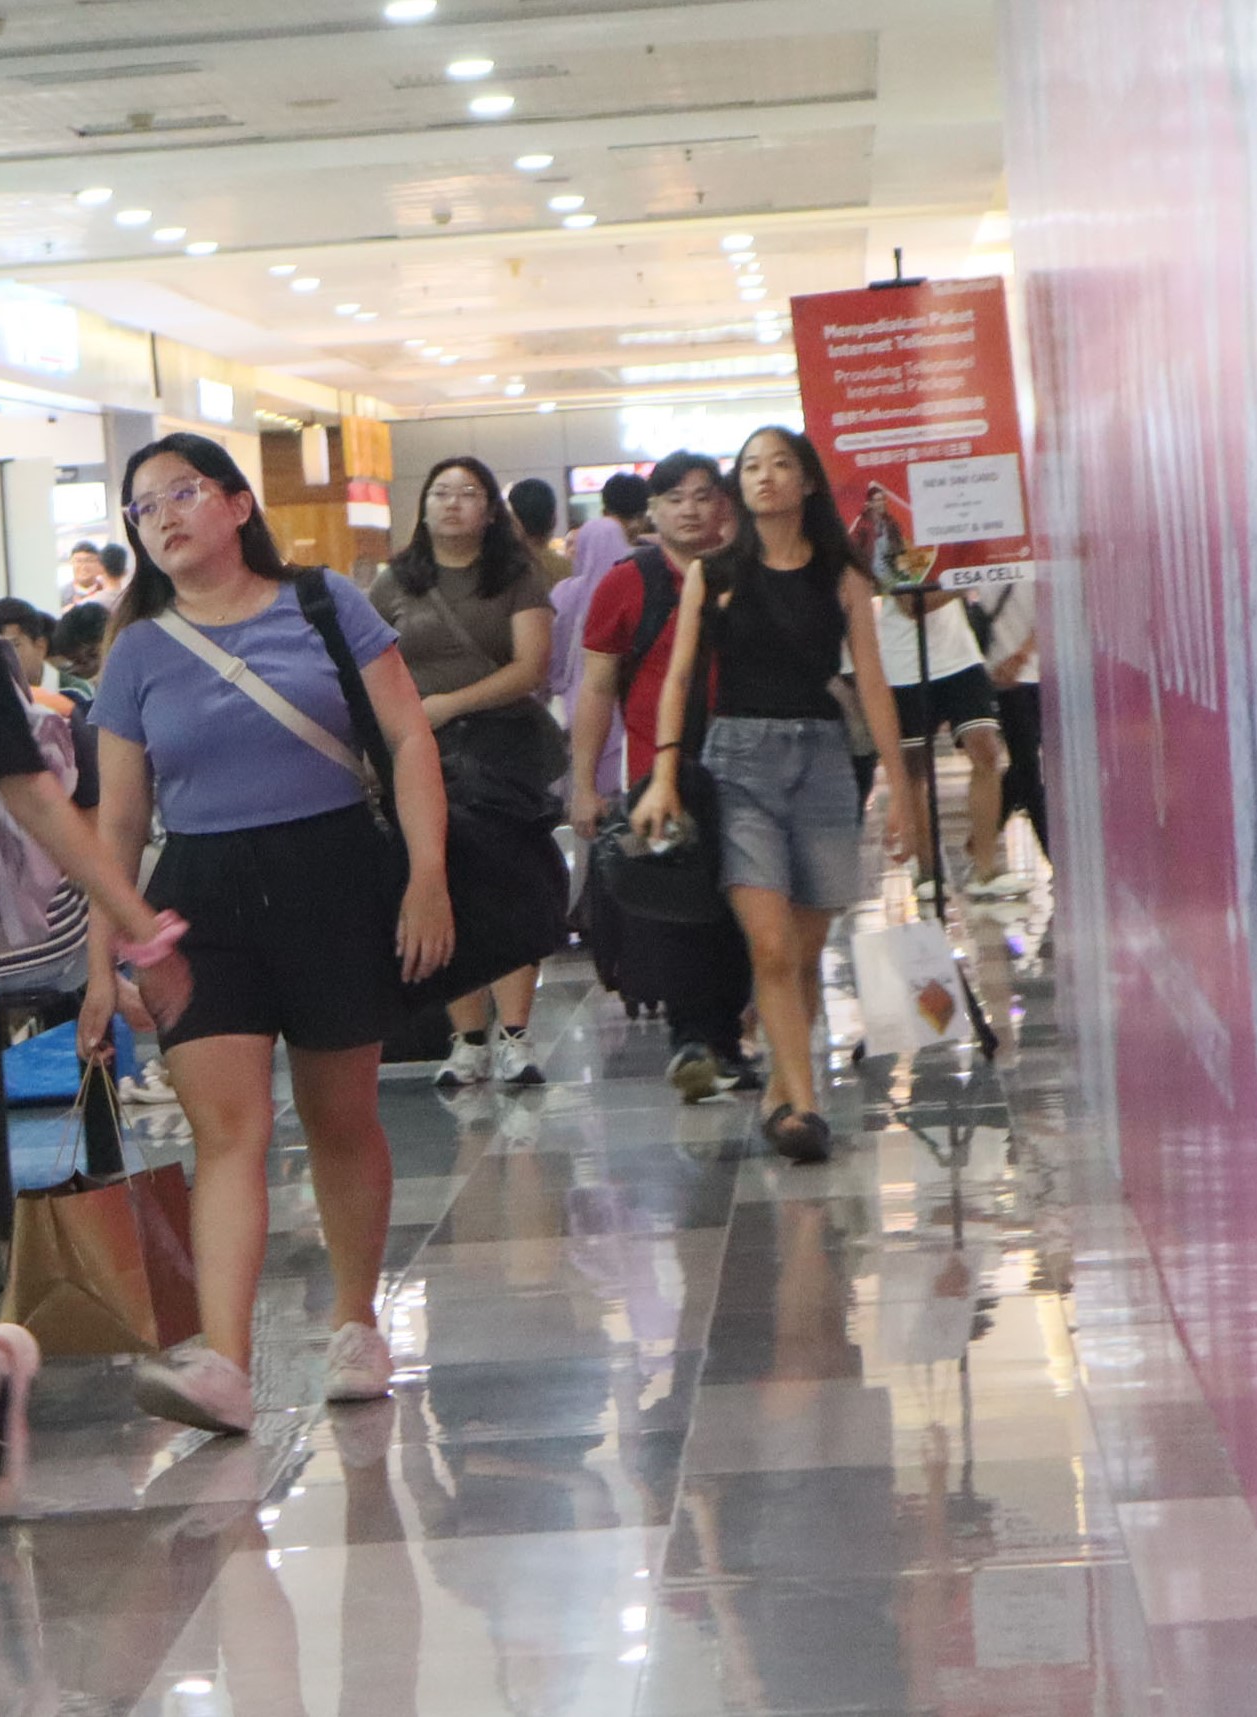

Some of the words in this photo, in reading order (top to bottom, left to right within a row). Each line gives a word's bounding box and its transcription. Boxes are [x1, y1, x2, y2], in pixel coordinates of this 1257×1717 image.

[828, 338, 893, 359] Internet
[834, 364, 902, 385] Providing
[846, 381, 905, 400] Internet
[953, 569, 983, 587] ESA
[986, 566, 1025, 583] CELL
